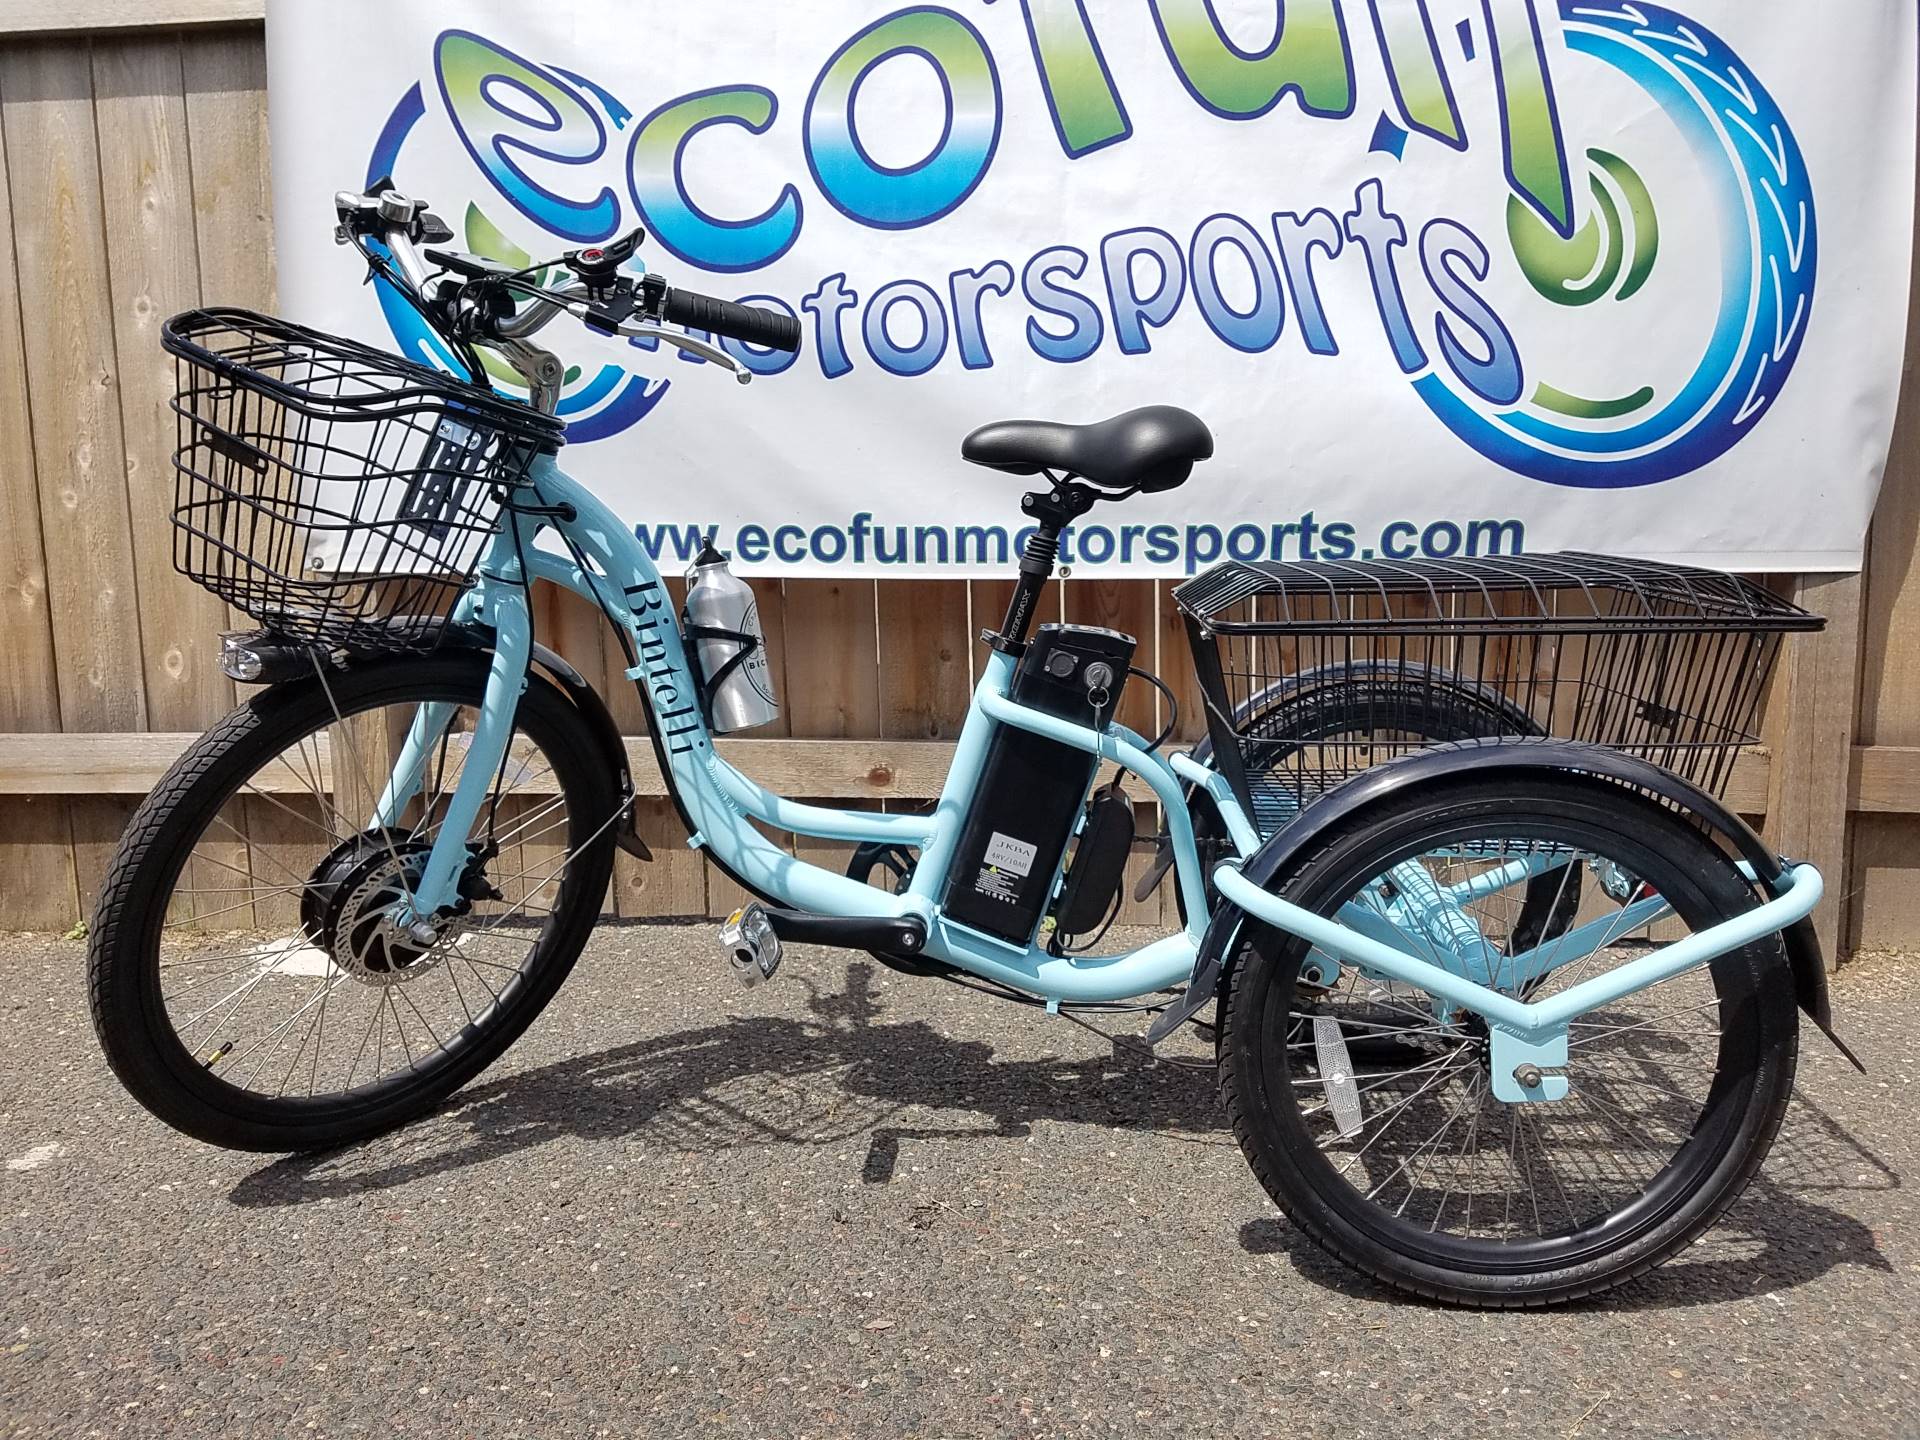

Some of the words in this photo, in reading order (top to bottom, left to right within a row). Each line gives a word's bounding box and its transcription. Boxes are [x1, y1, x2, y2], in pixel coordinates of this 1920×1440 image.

[584, 177, 1524, 406] otorsports
[624, 581, 705, 755] Bintelli
[996, 841, 1030, 857] JKBA
